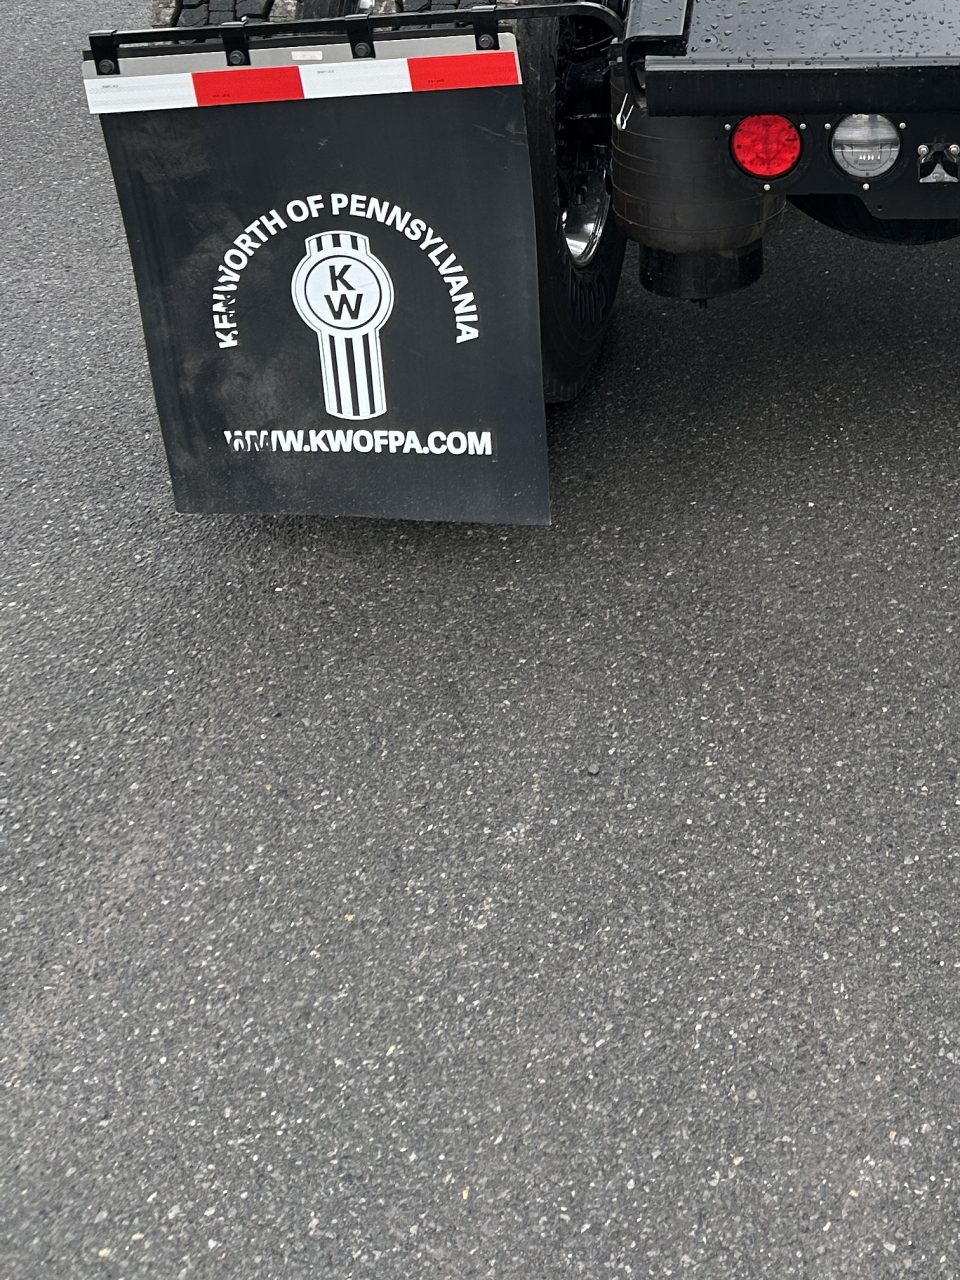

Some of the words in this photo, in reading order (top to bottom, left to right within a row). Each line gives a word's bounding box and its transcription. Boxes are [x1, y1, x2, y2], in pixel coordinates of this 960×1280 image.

[212, 208, 288, 349] KENWORTH
[286, 194, 325, 223] OF
[330, 193, 479, 344] PENNSYLVANIA
